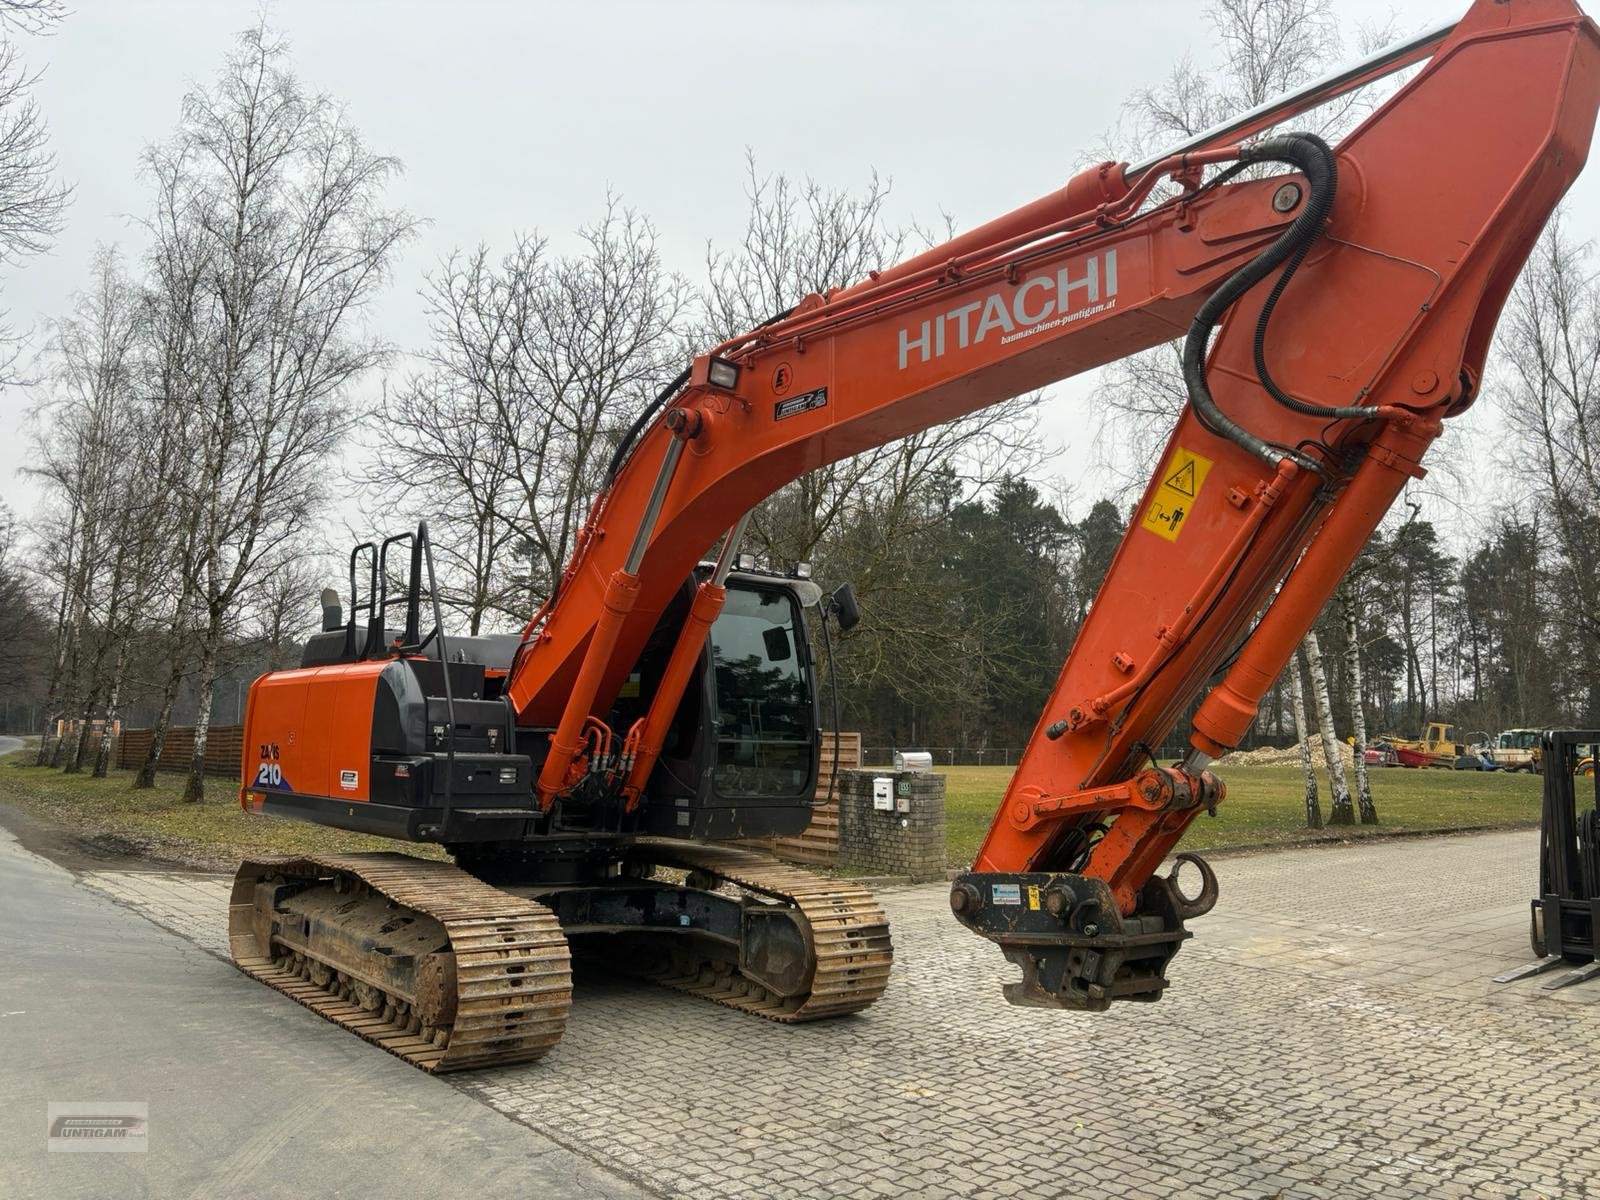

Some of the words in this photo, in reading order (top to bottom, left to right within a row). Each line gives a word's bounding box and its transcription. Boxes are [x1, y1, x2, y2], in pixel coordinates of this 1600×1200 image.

[898, 249, 1118, 370] HITACHI
[1000, 298, 1117, 345] baumaschinen-puntigam.at
[259, 763, 282, 785] 210
